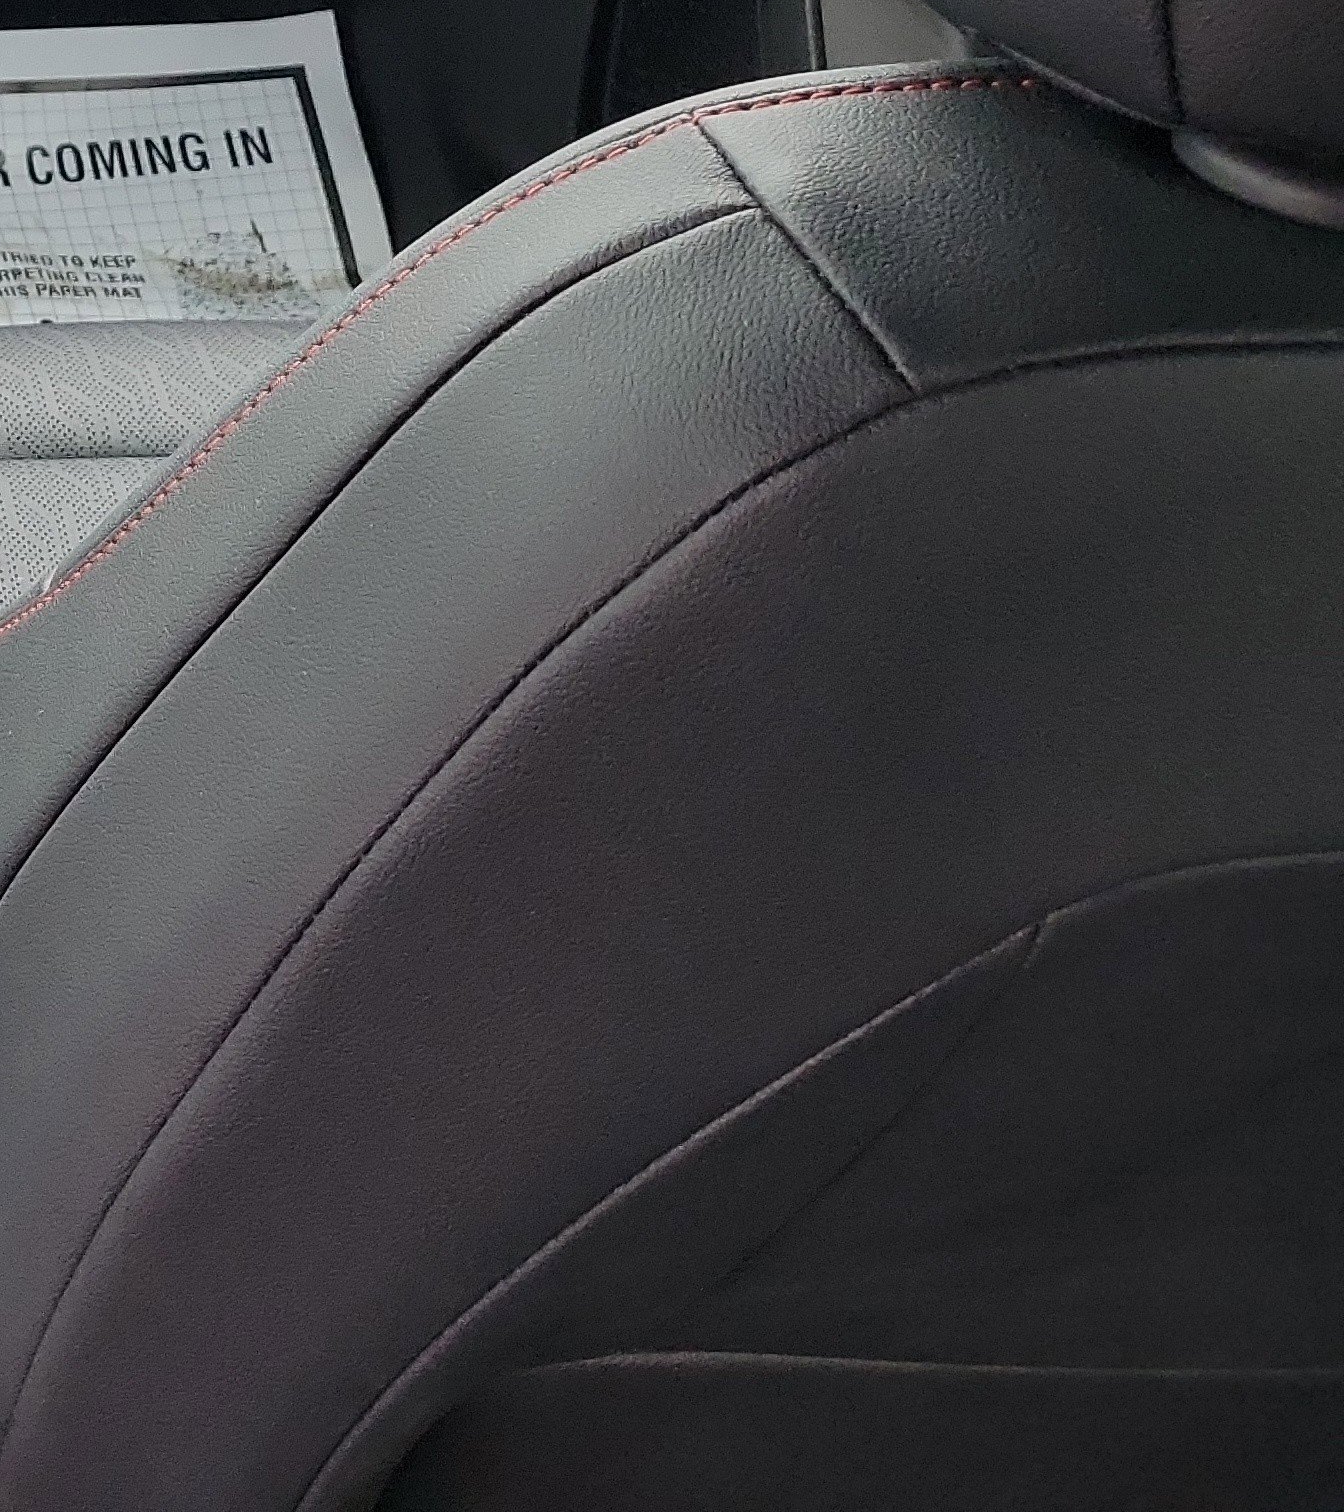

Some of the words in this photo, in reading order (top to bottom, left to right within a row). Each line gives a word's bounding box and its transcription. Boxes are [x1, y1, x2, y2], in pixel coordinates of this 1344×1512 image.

[25, 131, 211, 186] COMING
[223, 125, 273, 168] IN
[59, 254, 85, 268] TO
[88, 254, 136, 270] KEEP
[34, 282, 98, 299] PAPER
[103, 286, 143, 299] MAT
